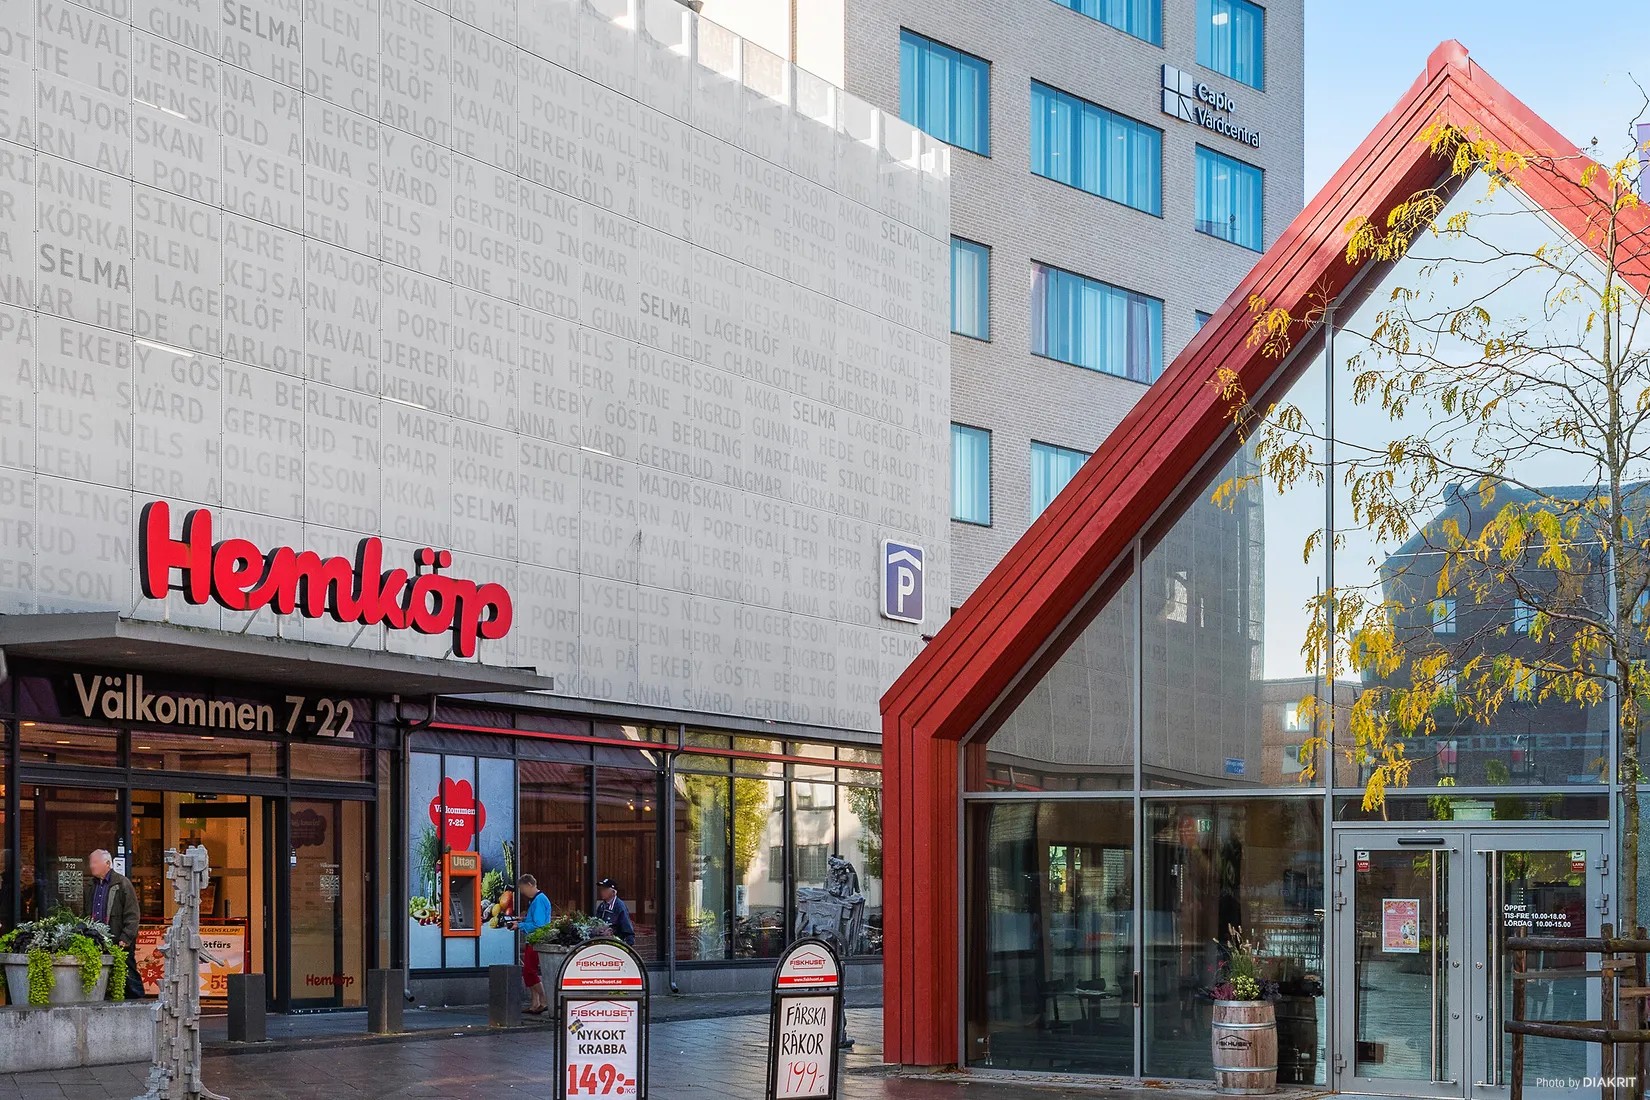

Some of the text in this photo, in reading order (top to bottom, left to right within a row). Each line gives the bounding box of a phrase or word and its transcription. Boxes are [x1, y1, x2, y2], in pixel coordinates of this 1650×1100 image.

[38, 0, 578, 227] KAVALJERERNA PÅ EKEBY GÖSTA BERLING
[153, 6, 613, 210] GUNNAR HEDE CHARLOTTE LÖWENSKÖLD
[223, 0, 637, 190] SELMA LAGERLÖF KAVALJERERNA PÅ
[1197, 82, 1236, 112] Capio
[382, 27, 836, 243] KEJSARN AV HERR ARNE INGRID
[1196, 106, 1261, 148] Vårdcentral
[97, 60, 625, 276] LÖWENSKÖLD ANNA SVÄRD GERTRUD INGMAR
[38, 80, 920, 407] MAJORSKAN LYSELIUS NILS HOLGERSSON AKKA SELMA LAGERLÖF KAVALJERERNA PÅ
[881, 220, 920, 254] SELMA
[96, 142, 904, 427] AV PORTUGALLIEN HERR ARNE INGRID GUNNAR HEDE CHARLOTTE LÖWENSKÖLD
[38, 200, 935, 487] KÖRKARLEN KEJSARN AV PORTUGALLIEN HERR ARNE INGRID GUNNAR HEDE CHARLOTTE
[135, 191, 912, 453] SINCLAIRE MAJORSKAN LYSELIUS NILS HOLGERSSON AKKA SELMA LAGERLÖF
[38, 242, 912, 506] SELMA LAGERLÖF KAVALJERERNA PÅ EKEBY GÖSTA BERLING MARIANNE SINCLAIRE
[58, 326, 862, 544] EKEBY GÖSTA BERLING MARIANNE SINCLAIRE MAJORSKAN LYSELIUS NILS
[97, 298, 935, 538] HEDE CHARLOTTE LÖWENSKÖLD ANNA SVÄRD GERTRUD INGMAR KÖRKARLEN KEJSARN
[17, 359, 93, 401] ANNA
[116, 381, 202, 425] SVÄRD
[224, 405, 333, 454] GERTRUD
[352, 435, 436, 477] INGMAR
[581, 488, 658, 526] KEJSARN
[671, 510, 691, 533] AV
[703, 516, 818, 561] PORTUGALLIEN
[829, 545, 862, 571] HERR
[453, 492, 791, 583] SELMA PÅ
[140, 501, 513, 658] Hemköp
[898, 565, 915, 613] P
[616, 645, 702, 681] PÅ EKEBY
[682, 629, 722, 655] HERR
[880, 635, 920, 660] SELMA
[73, 673, 355, 740] Välkommen 7-22
[627, 681, 870, 731] ANNA SVÄRD GERTRUD INGMAR
[434, 804, 476, 815] Vkommen
[448, 818, 465, 827] 7-22
[453, 856, 476, 869] Uttag
[570, 1009, 635, 1017] FISKHUSET
[577, 1030, 626, 1041] NYKOKT
[786, 1003, 827, 1026] FÄRSKA
[578, 1044, 627, 1055] KRABBA
[781, 1030, 824, 1056] RÄKOR
[567, 1063, 636, 1095] 149:-
